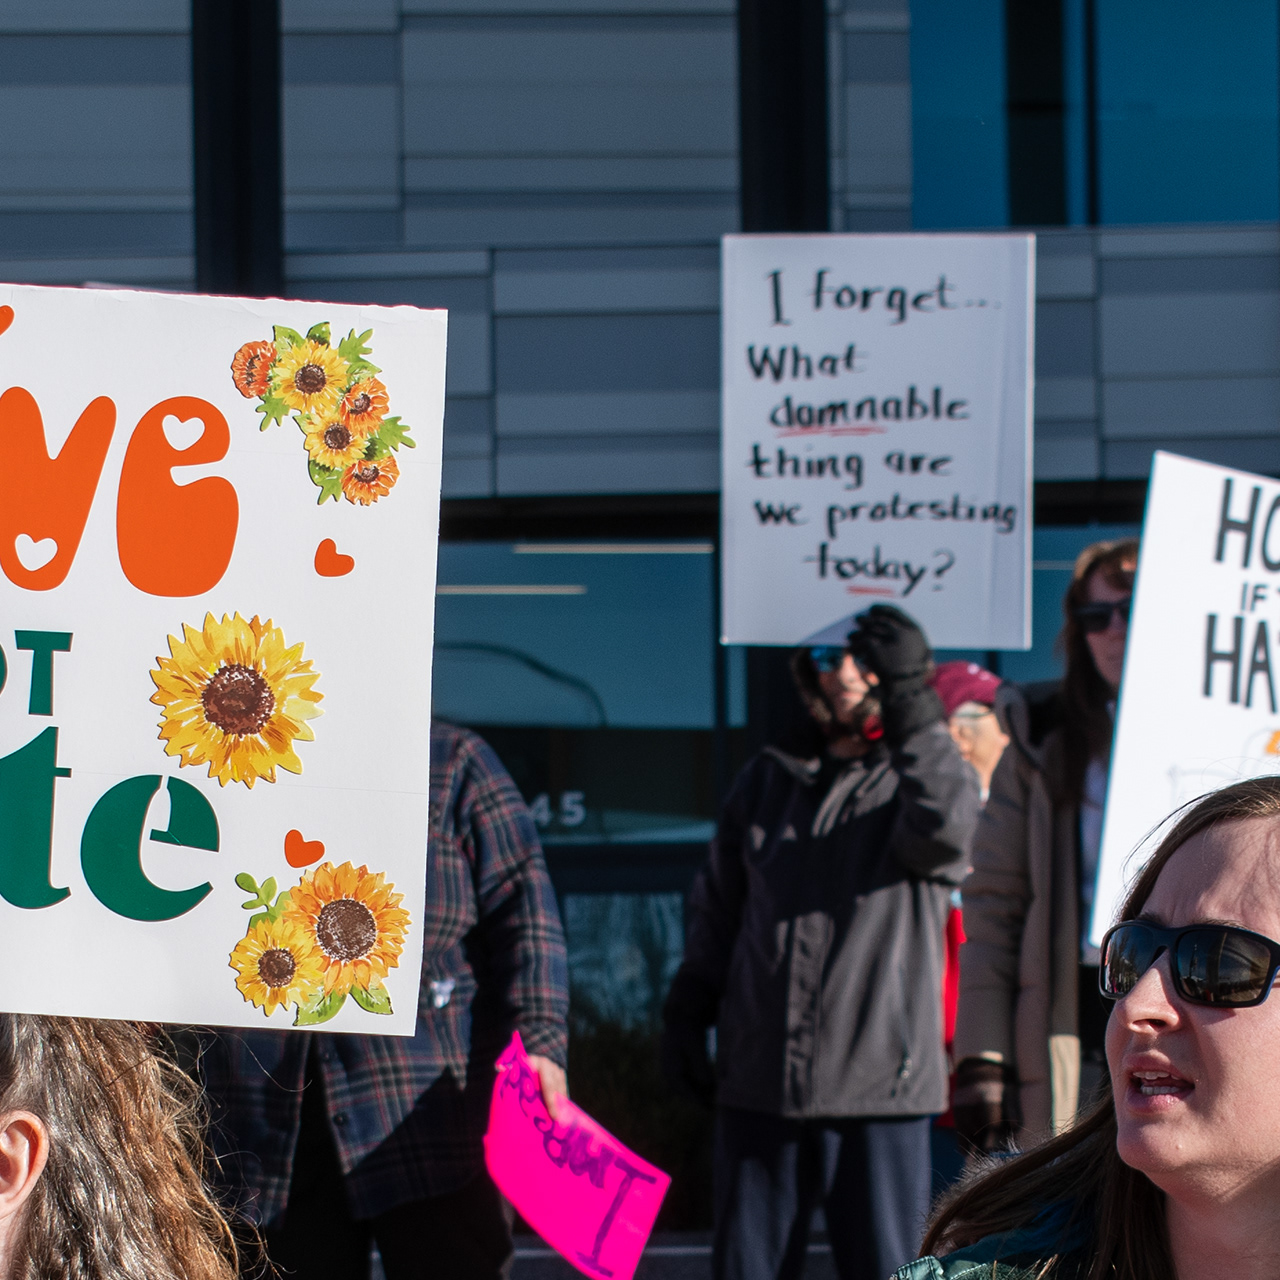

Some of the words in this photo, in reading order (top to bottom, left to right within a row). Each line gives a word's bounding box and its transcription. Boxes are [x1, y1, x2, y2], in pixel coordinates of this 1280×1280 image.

[768, 269, 791, 326] I
[747, 343, 868, 383] What
[770, 386, 970, 429] damnable
[746, 443, 863, 490] thing
[885, 449, 953, 476] are
[827, 493, 1018, 540] protesting
[803, 541, 955, 598] today?
[1240, 582, 1270, 614] IF
